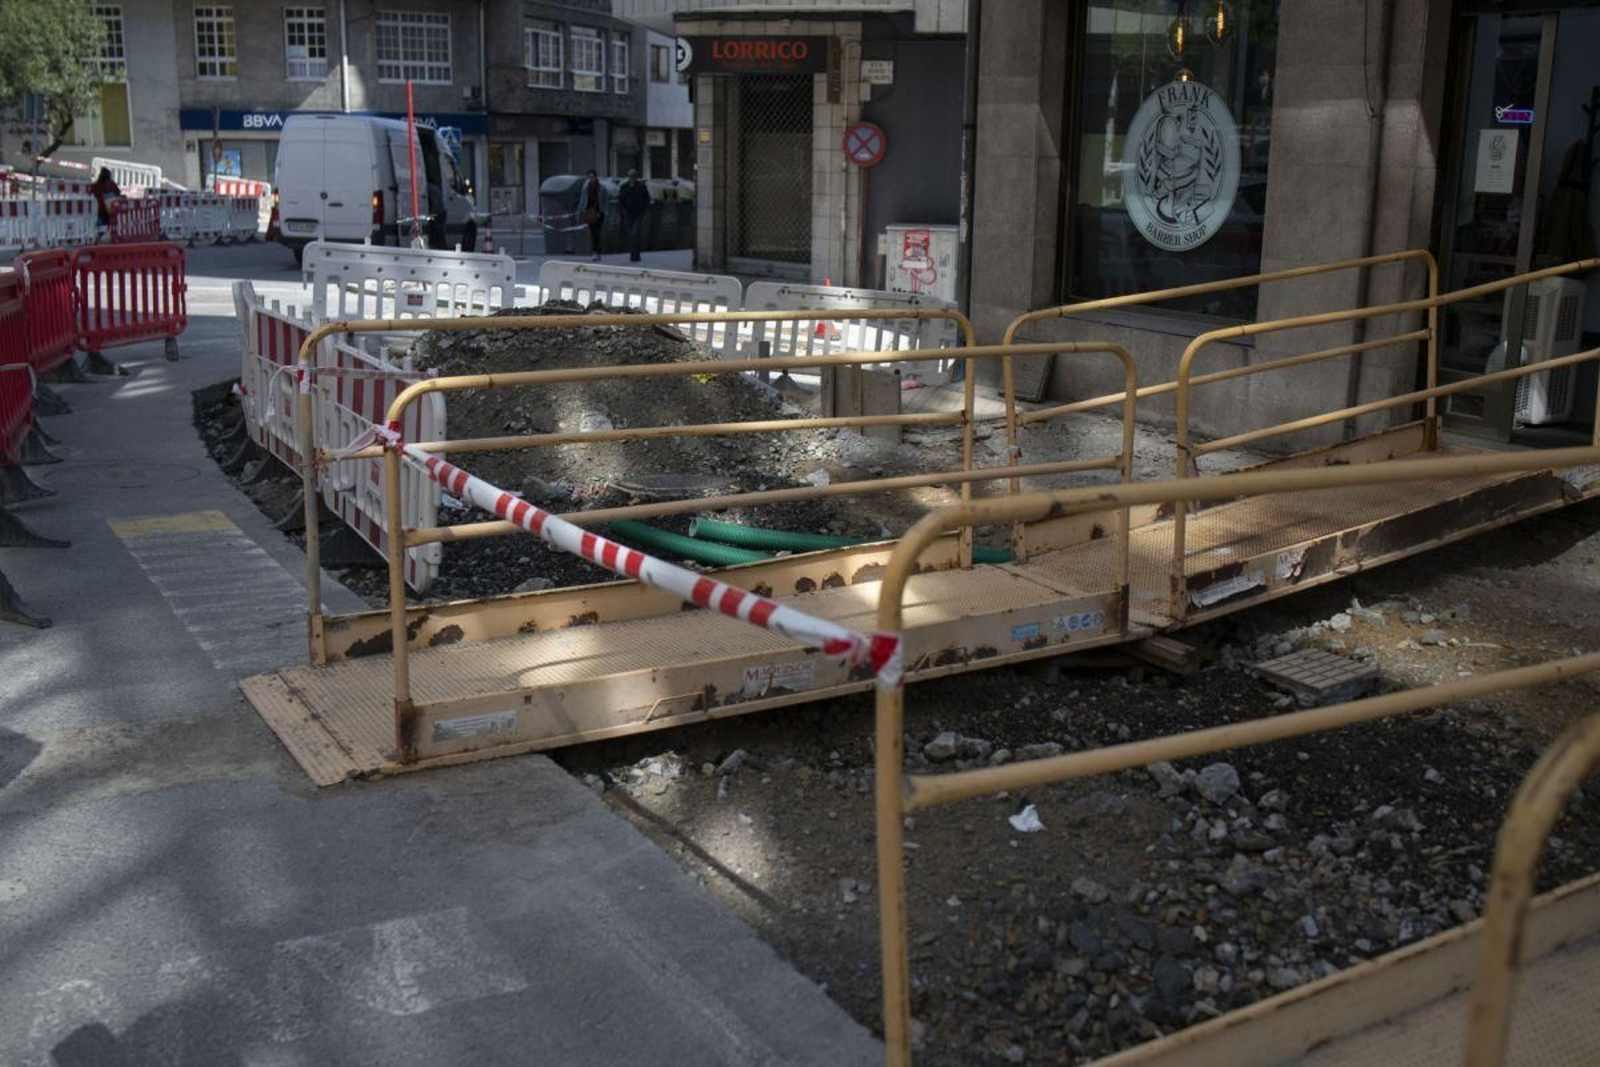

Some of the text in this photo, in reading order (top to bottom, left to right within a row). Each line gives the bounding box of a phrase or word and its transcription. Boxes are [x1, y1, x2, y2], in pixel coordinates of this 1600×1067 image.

[711, 41, 809, 60] LORRICO
[1157, 84, 1214, 109] FRANK
[243, 114, 283, 128] BBVA
[1146, 222, 1208, 246] BARBER SHOP
